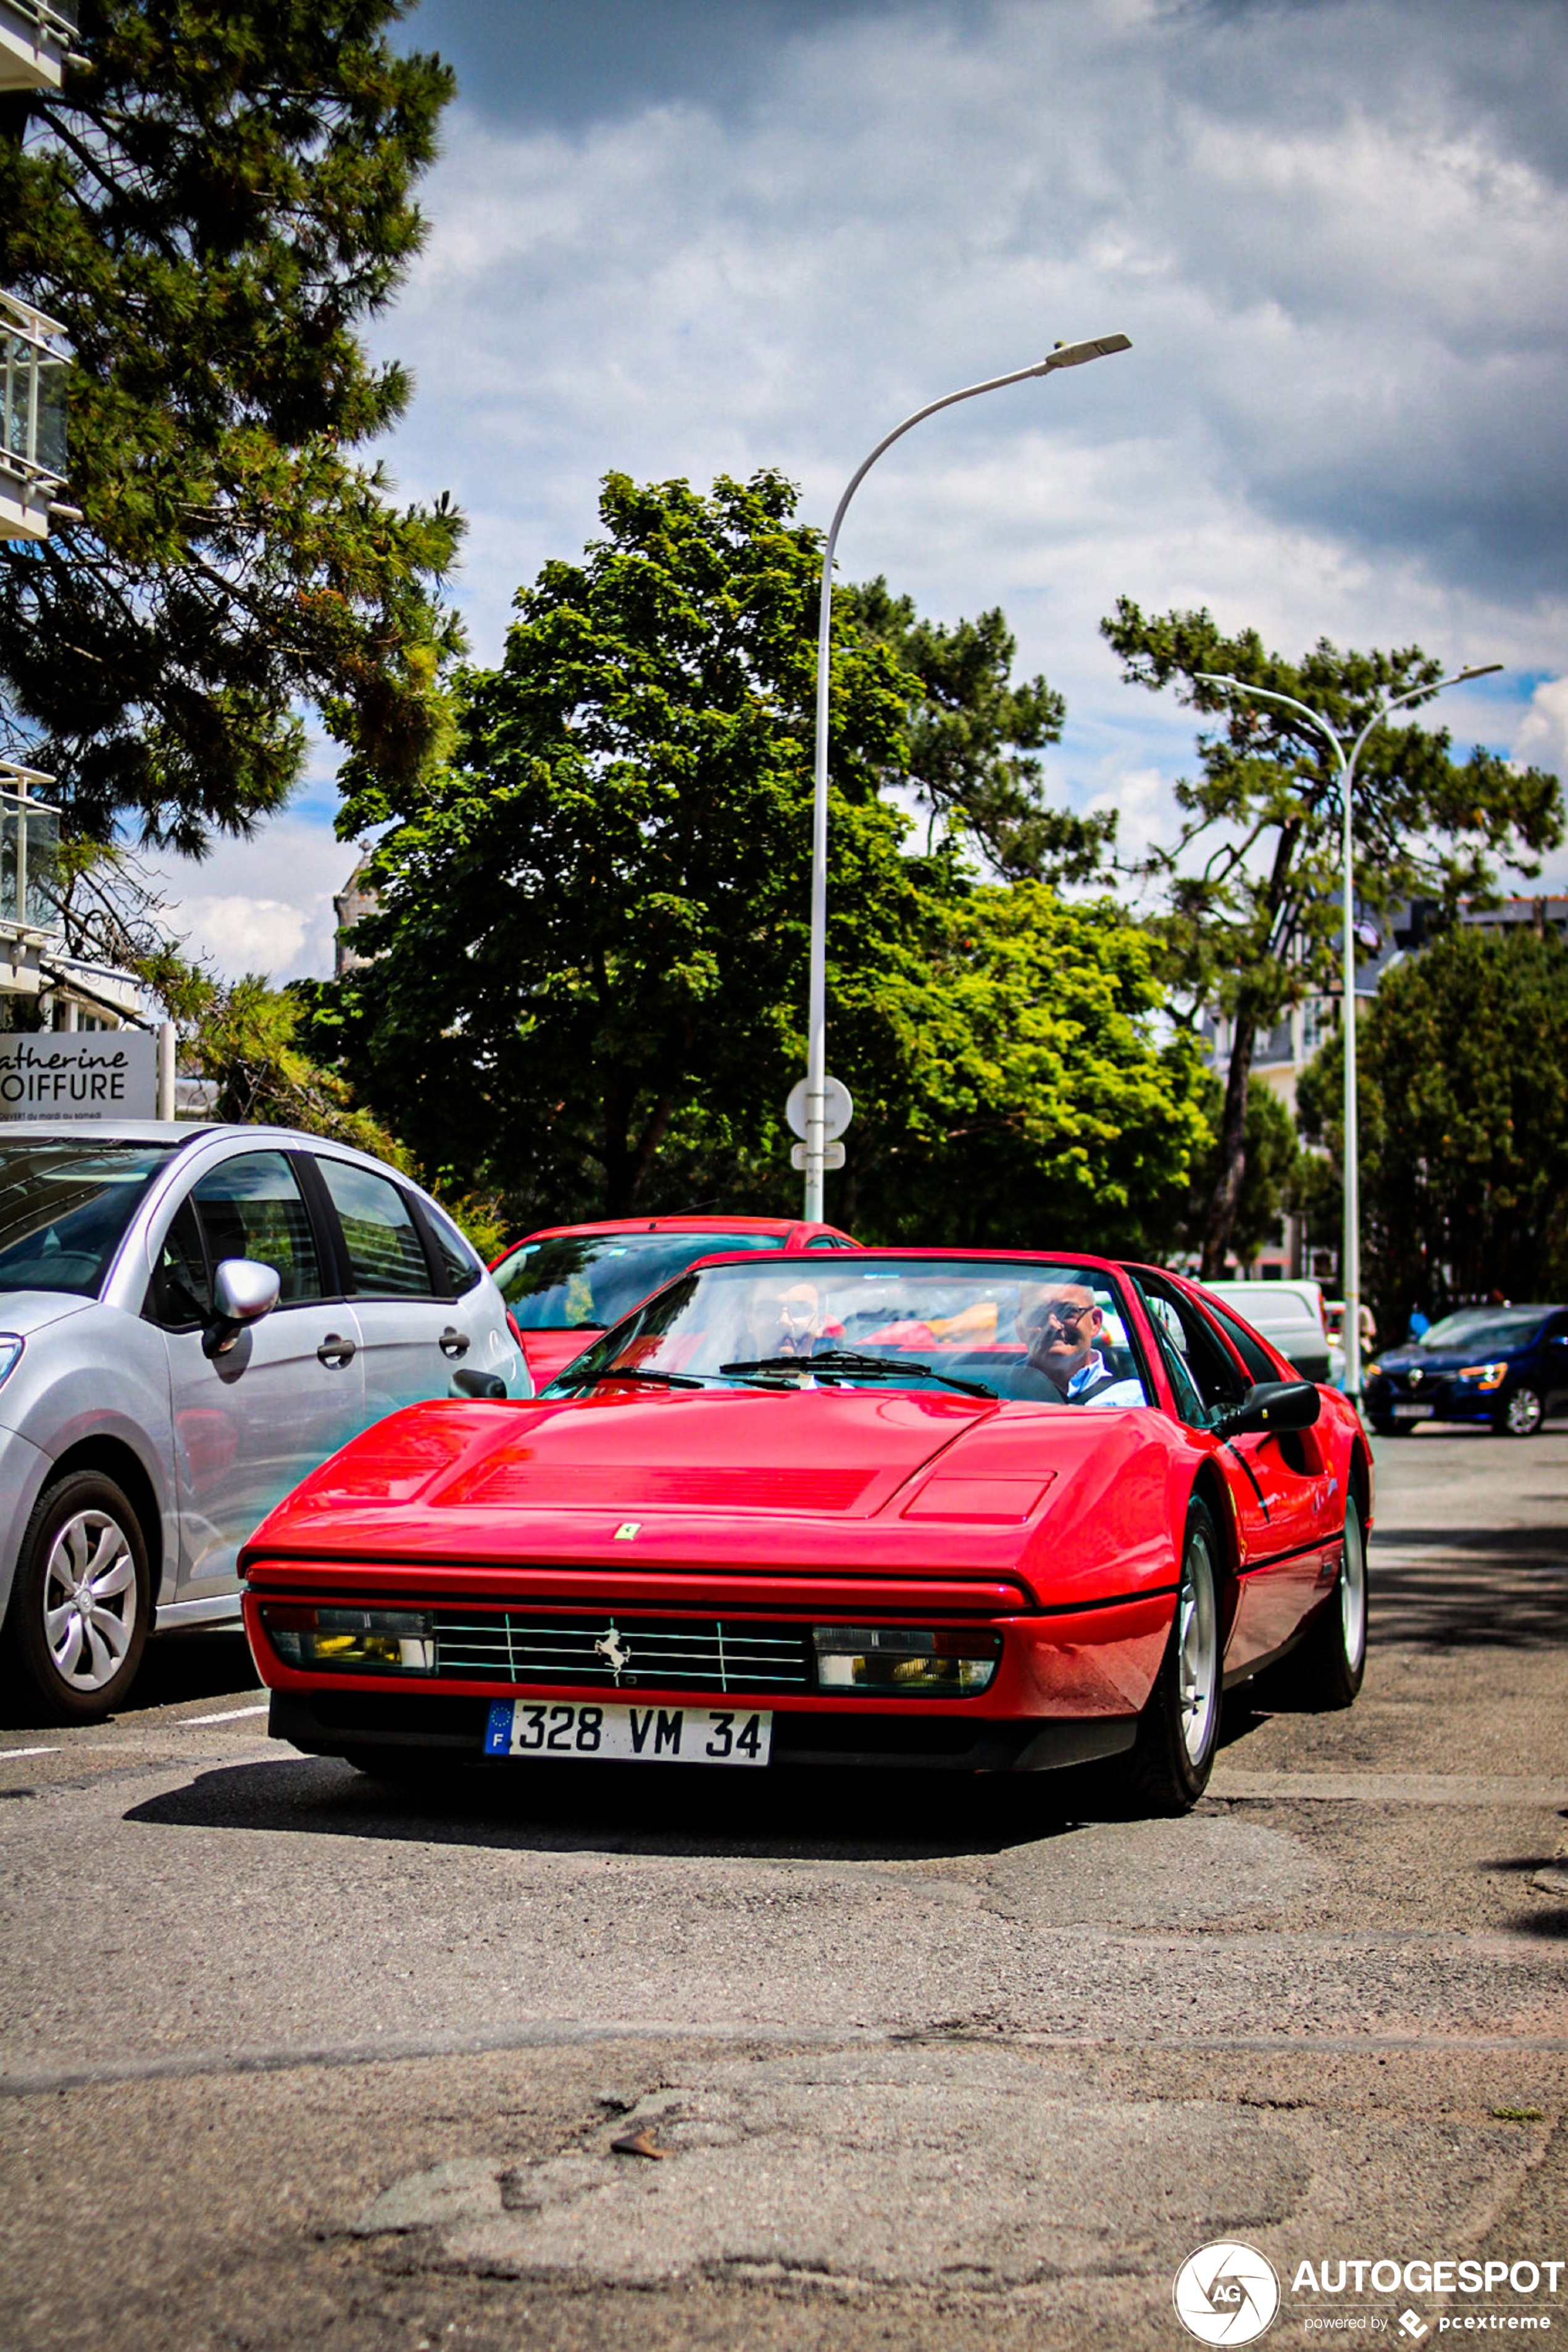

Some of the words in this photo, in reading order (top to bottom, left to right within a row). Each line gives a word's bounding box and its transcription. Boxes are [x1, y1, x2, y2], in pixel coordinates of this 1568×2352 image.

[0, 1073, 125, 1103] OIFFURE
[493, 1733, 504, 1747] F
[519, 1705, 603, 1752] 328
[629, 1709, 684, 1754] VM
[706, 1712, 762, 1759] 34
